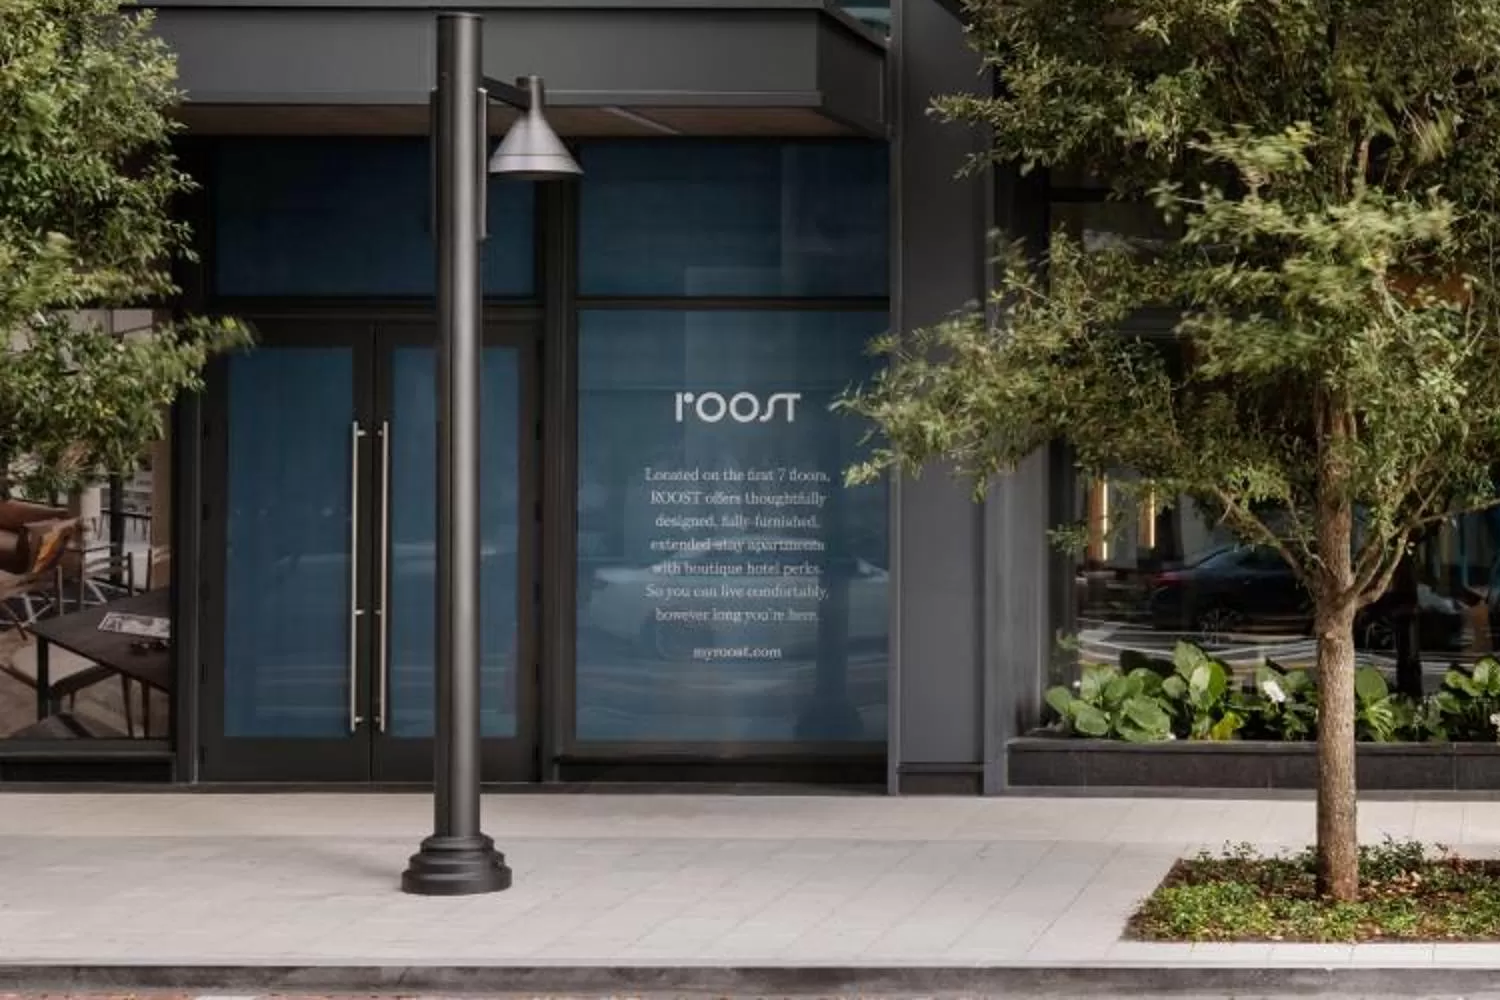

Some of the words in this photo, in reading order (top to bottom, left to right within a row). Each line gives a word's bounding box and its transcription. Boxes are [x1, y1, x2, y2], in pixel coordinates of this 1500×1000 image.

[644, 467, 699, 481] Located
[702, 471, 719, 481] on
[723, 467, 744, 481] the
[747, 467, 773, 481] first
[777, 468, 786, 481] 7
[705, 491, 741, 505] offers
[745, 491, 827, 507] thoughtfully
[651, 560, 681, 574] with
[683, 560, 743, 576] boutique
[747, 560, 779, 574] hotel
[645, 584, 663, 597] So
[664, 587, 690, 600] you
[693, 587, 717, 597] can
[721, 584, 745, 597] live
[655, 607, 711, 621] however
[712, 607, 741, 623] long
